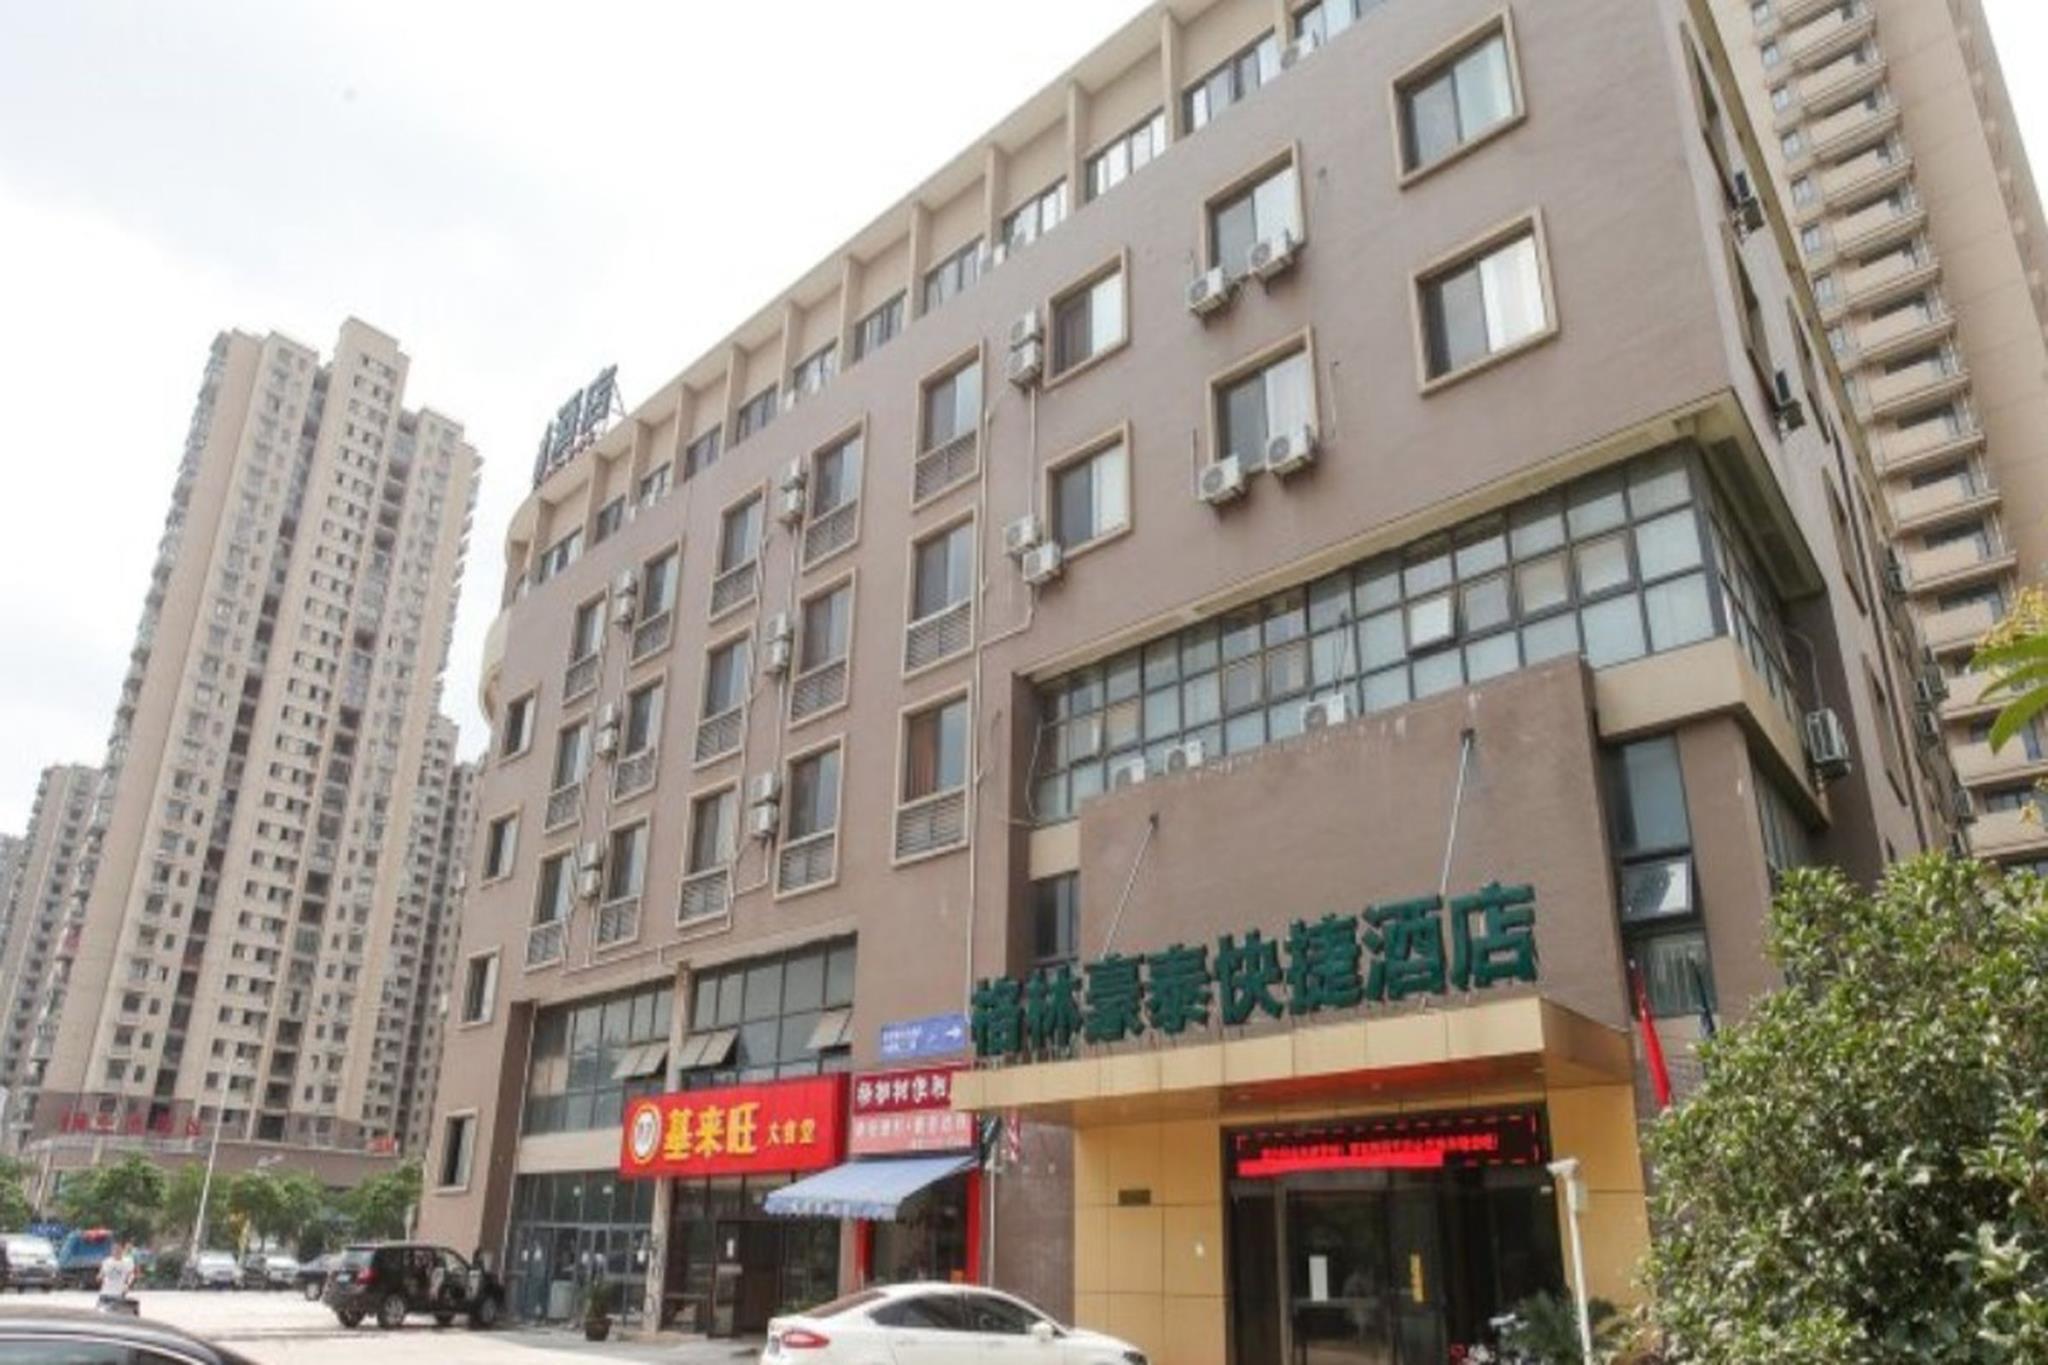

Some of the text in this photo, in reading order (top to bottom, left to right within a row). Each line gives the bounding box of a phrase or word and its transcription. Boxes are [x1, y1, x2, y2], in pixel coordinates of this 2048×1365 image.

[971, 881, 1537, 1057] 格林豪泰快捷酒店
